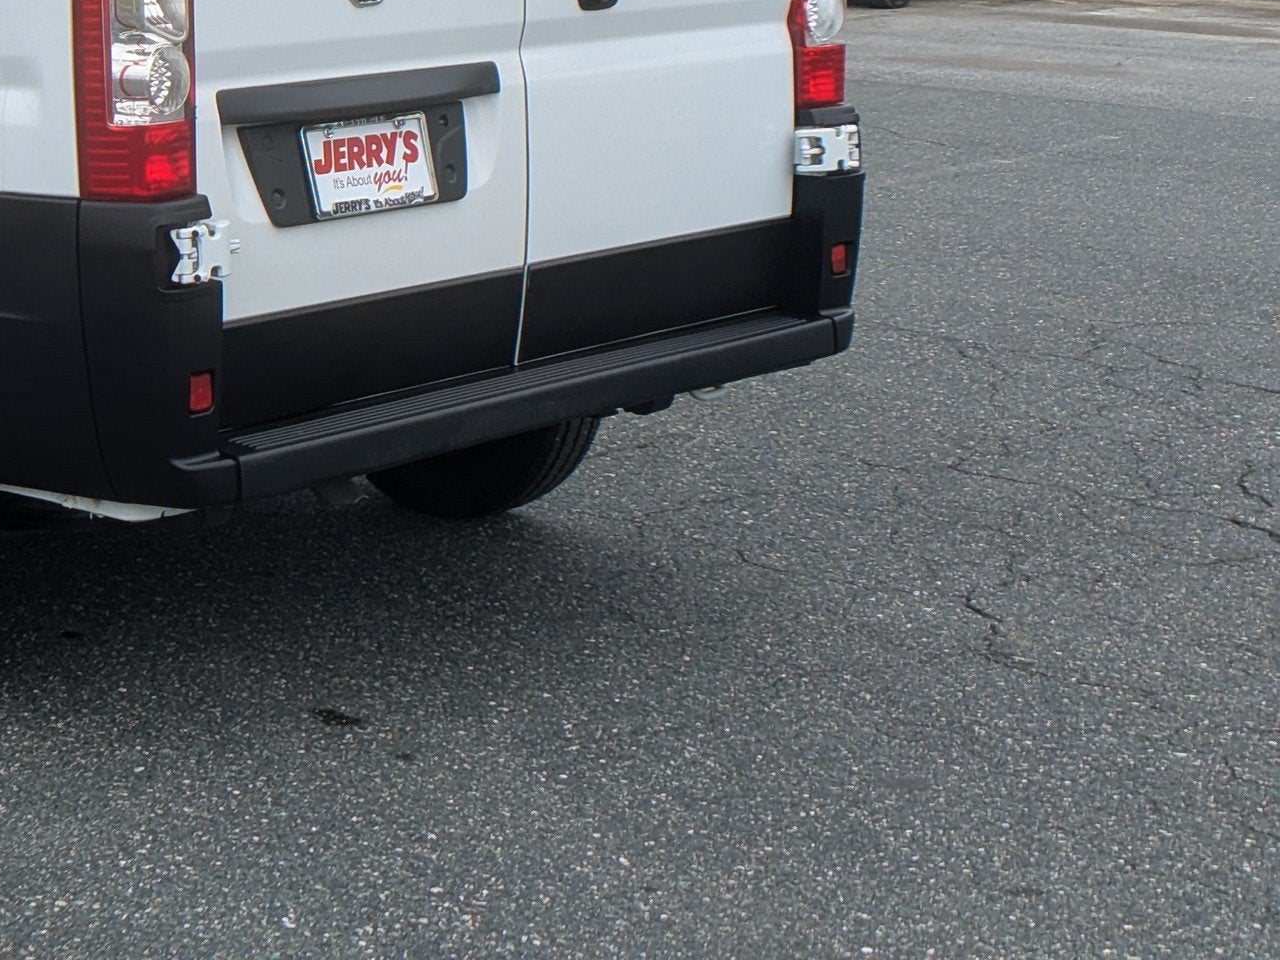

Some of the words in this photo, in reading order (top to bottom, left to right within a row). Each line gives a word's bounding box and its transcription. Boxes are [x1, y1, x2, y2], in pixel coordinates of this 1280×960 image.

[314, 130, 419, 175] JERRY'S
[334, 178, 345, 189] It's
[346, 174, 373, 188] About
[373, 162, 408, 192] you!
[333, 199, 371, 214] JERRY'S
